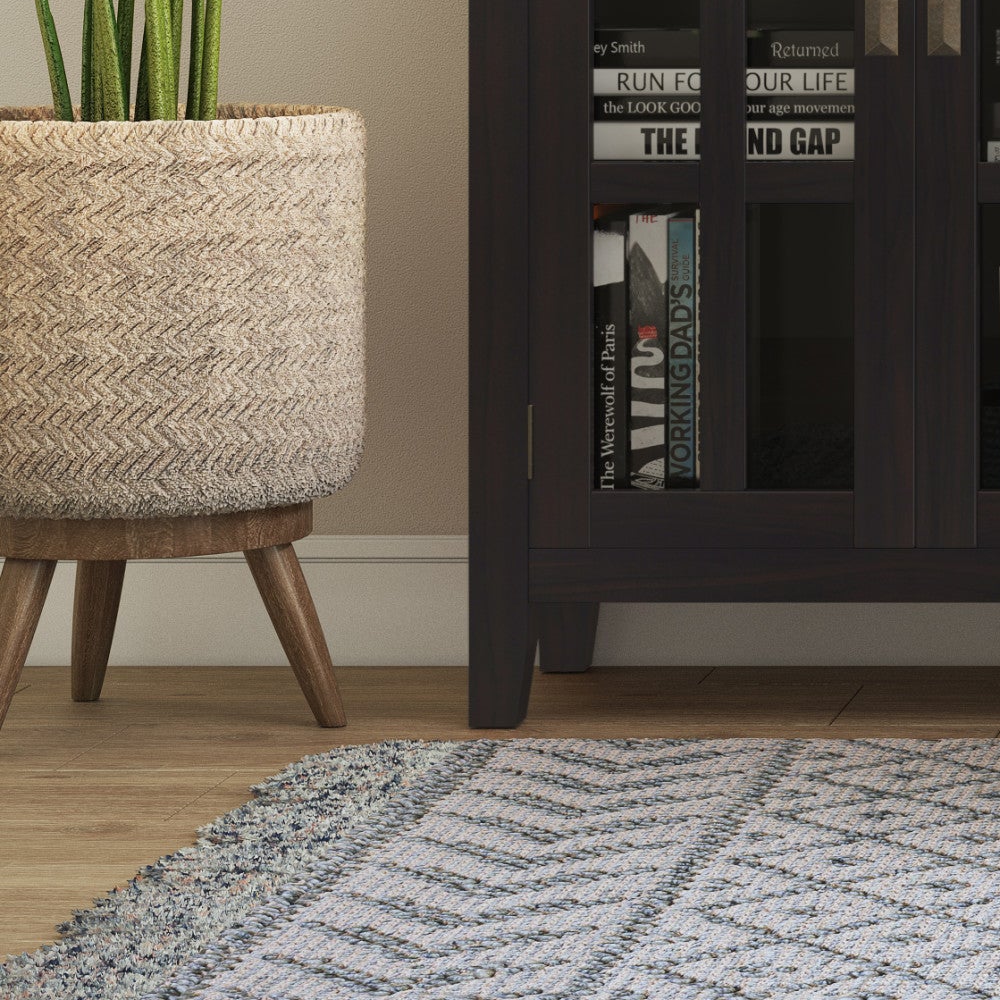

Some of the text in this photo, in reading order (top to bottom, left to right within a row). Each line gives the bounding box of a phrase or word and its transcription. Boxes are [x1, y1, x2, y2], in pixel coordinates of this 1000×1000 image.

[593, 40, 646, 57] ey Smith
[770, 41, 840, 59] Returned
[617, 72, 848, 92] RUN FO OUR LIFE
[603, 100, 624, 114] the
[627, 101, 667, 114] LOOK
[670, 101, 701, 114] GOO
[769, 104, 790, 117] age
[794, 104, 855, 114] movemen
[640, 128, 688, 155] THE
[790, 127, 841, 155] GAP
[671, 238, 679, 281] SURVIVAL
[682, 254, 690, 281] GUIDE
[670, 284, 692, 359] DAD'S
[600, 324, 616, 490] The Werewolf of Paris
